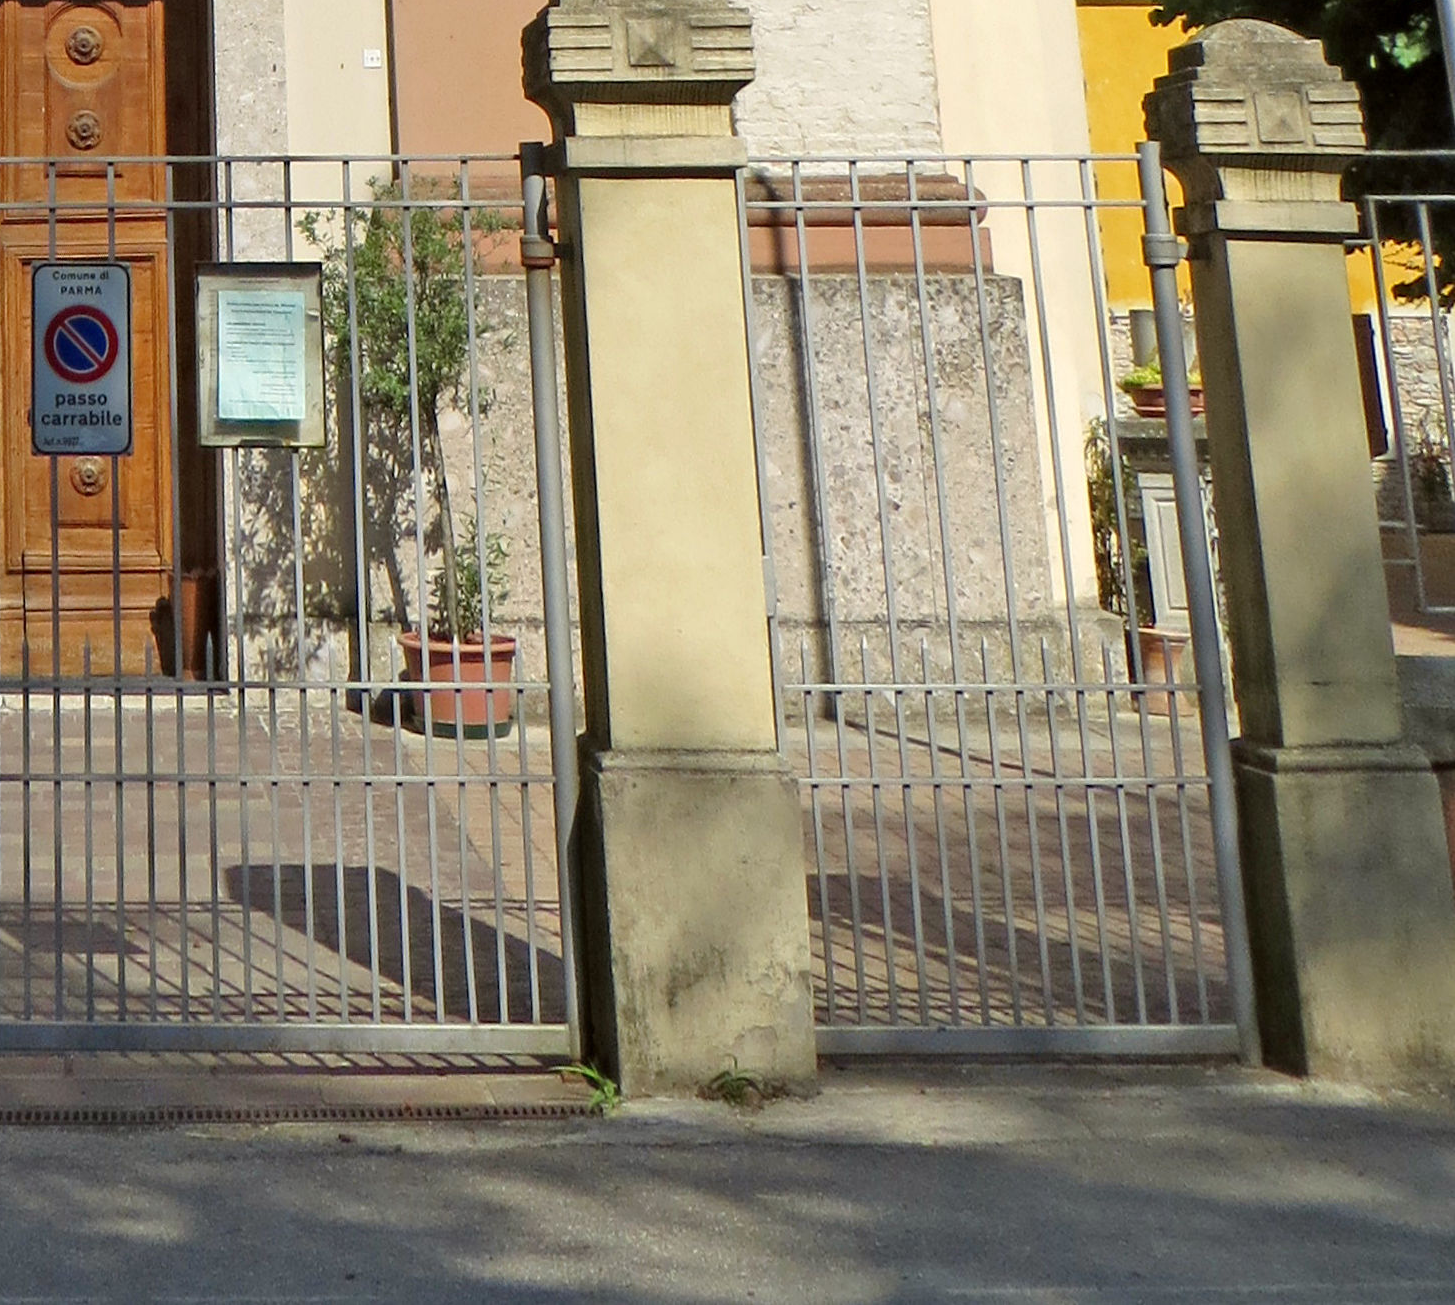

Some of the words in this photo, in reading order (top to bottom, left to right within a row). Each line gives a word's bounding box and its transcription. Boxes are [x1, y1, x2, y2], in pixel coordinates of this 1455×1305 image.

[52, 270, 96, 281] Comune
[99, 270, 110, 281] di
[60, 285, 103, 295] PARMA
[55, 393, 108, 408] passo
[41, 410, 122, 426] carrabile
